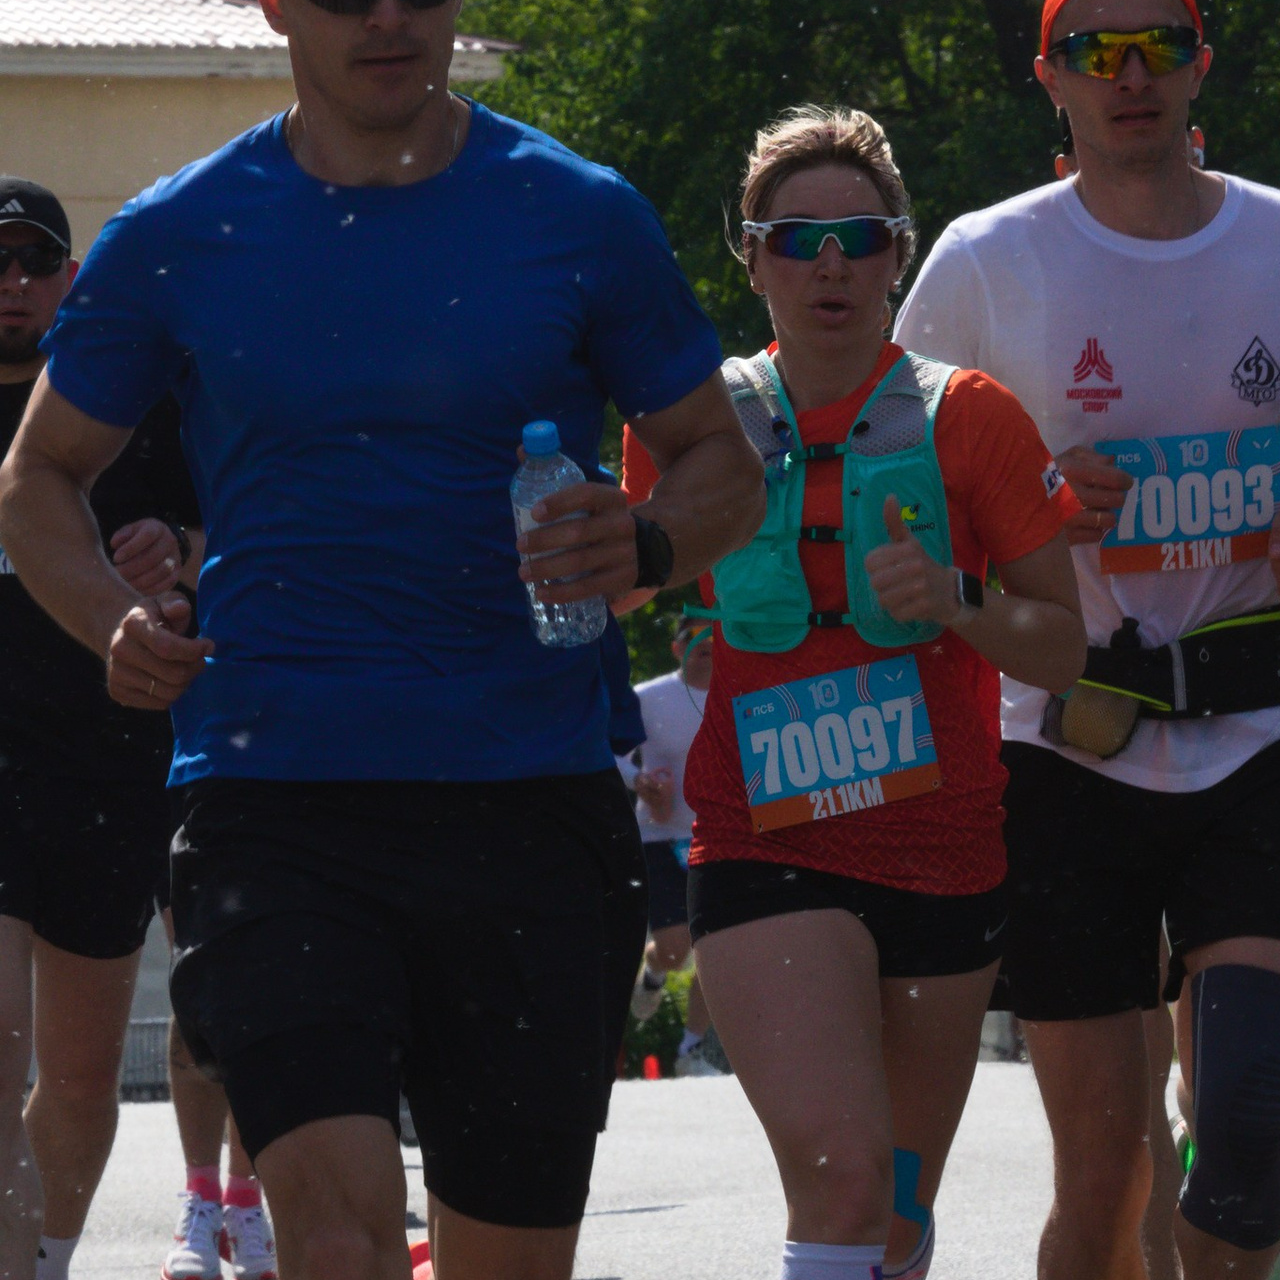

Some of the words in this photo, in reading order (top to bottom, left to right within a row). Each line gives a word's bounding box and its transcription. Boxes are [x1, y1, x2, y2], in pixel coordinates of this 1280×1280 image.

[1066, 385, 1123, 400] МОСКОВСКИЙ
[1243, 388, 1273, 399] МГО
[1082, 401, 1109, 413] СПОРТ
[1116, 452, 1142, 465] ПСБ
[1117, 464, 1276, 541] 70093
[910, 521, 936, 533] RHINO
[752, 702, 775, 718] ПСБ
[750, 695, 917, 795] 70097
